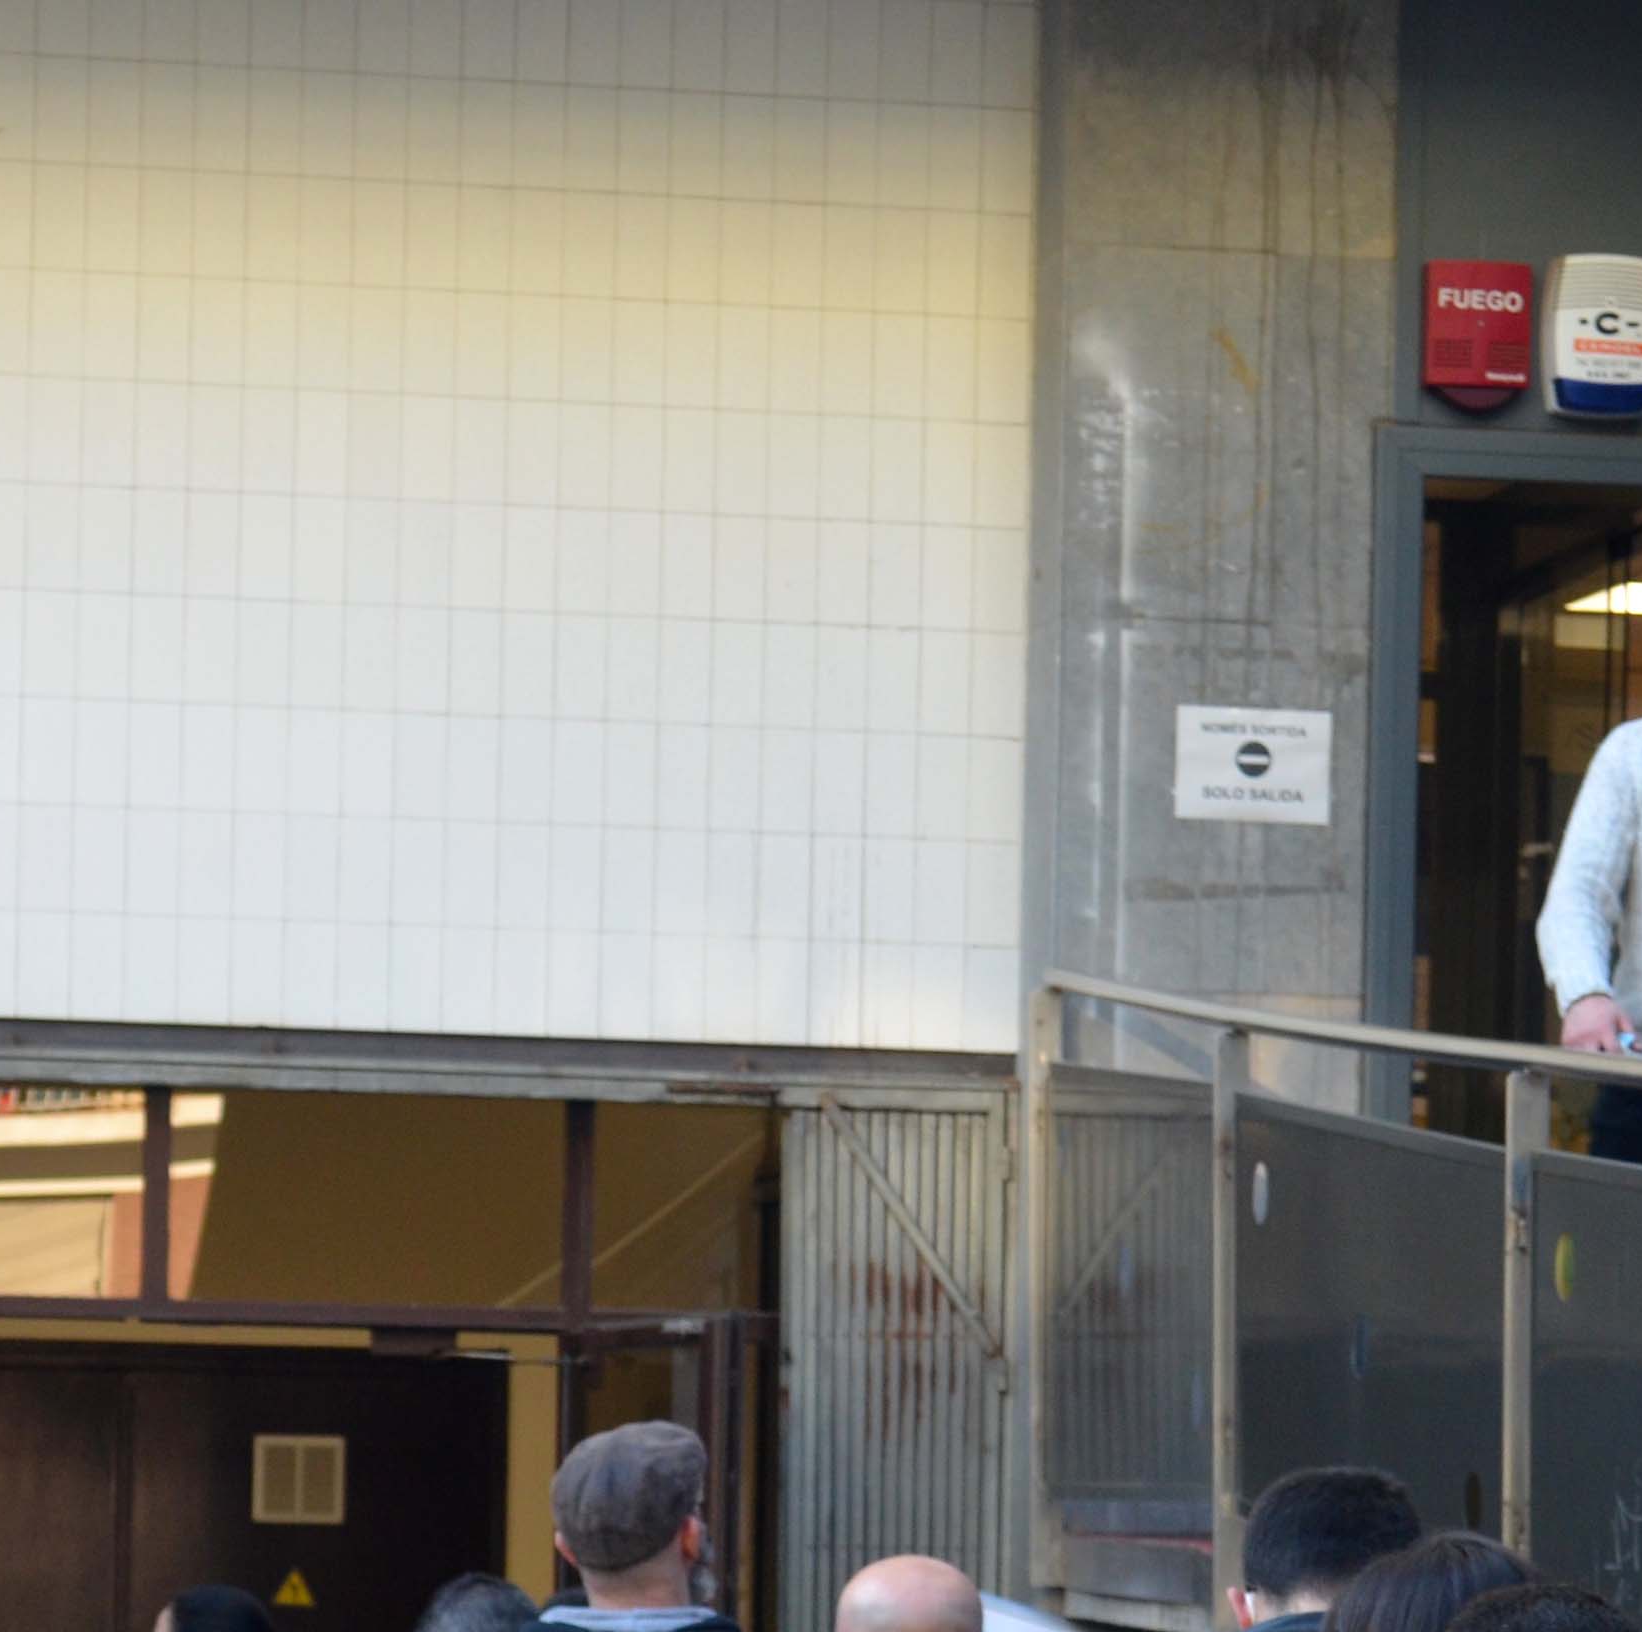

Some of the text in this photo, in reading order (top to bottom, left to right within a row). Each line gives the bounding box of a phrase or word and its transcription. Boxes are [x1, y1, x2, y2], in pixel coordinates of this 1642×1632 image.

[1438, 287, 1525, 313] FUEGO
[1203, 785, 1304, 802] SOLO SALIDA
